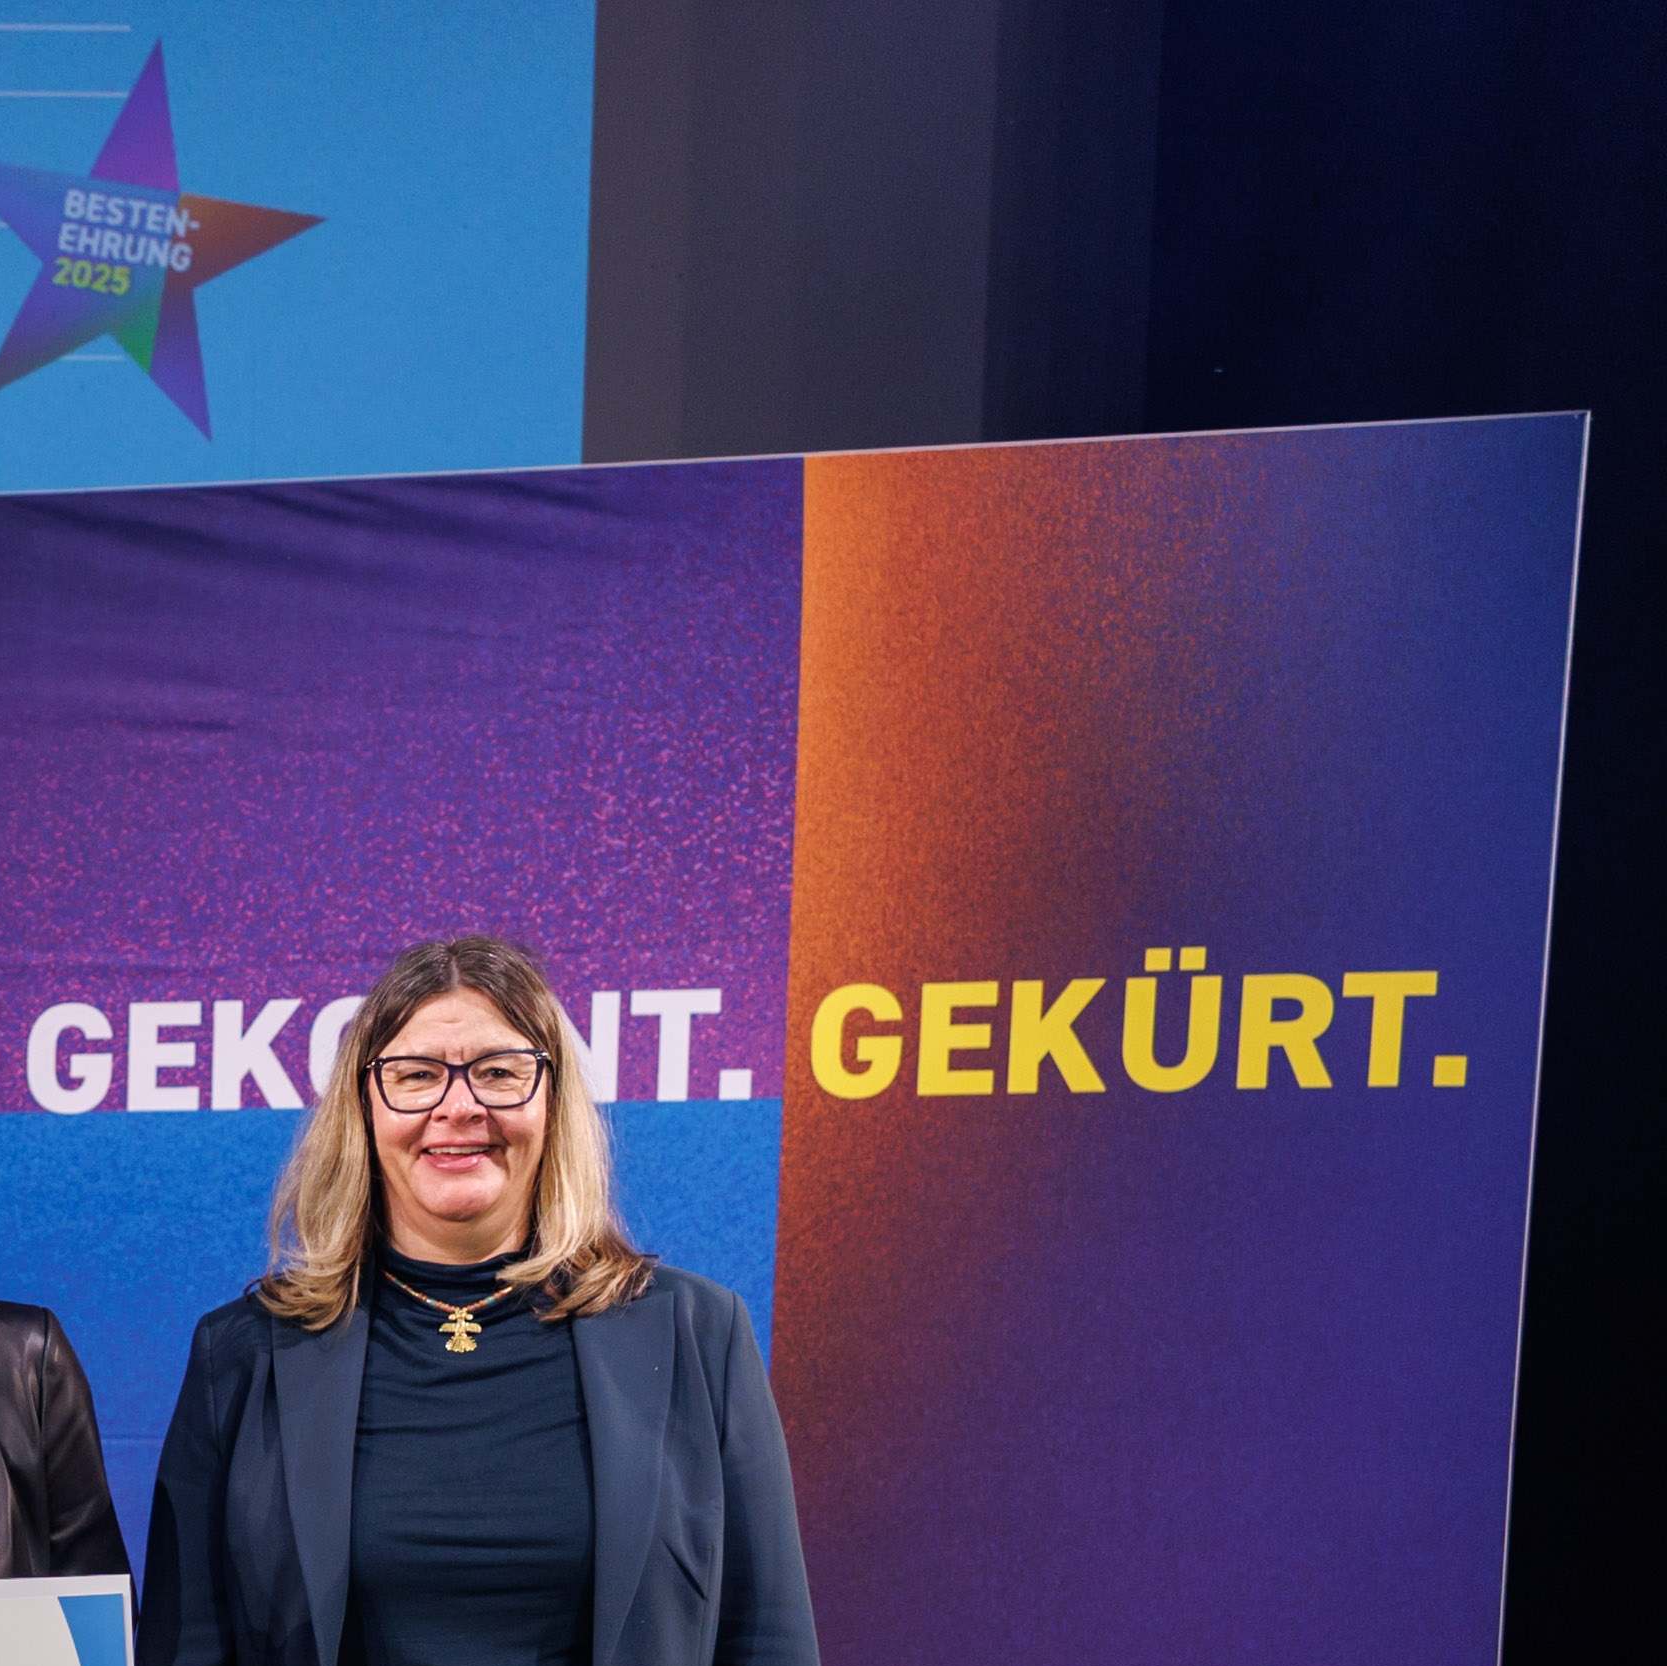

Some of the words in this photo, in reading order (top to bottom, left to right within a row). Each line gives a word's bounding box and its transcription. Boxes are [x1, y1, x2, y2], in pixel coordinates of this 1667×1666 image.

[63, 189, 201, 238] BESTEN-
[58, 223, 192, 272] EHRUNG
[52, 258, 131, 295] 2025
[26, 988, 752, 1114] GEKNT.
[810, 946, 1467, 1099] GEKÜRT.
